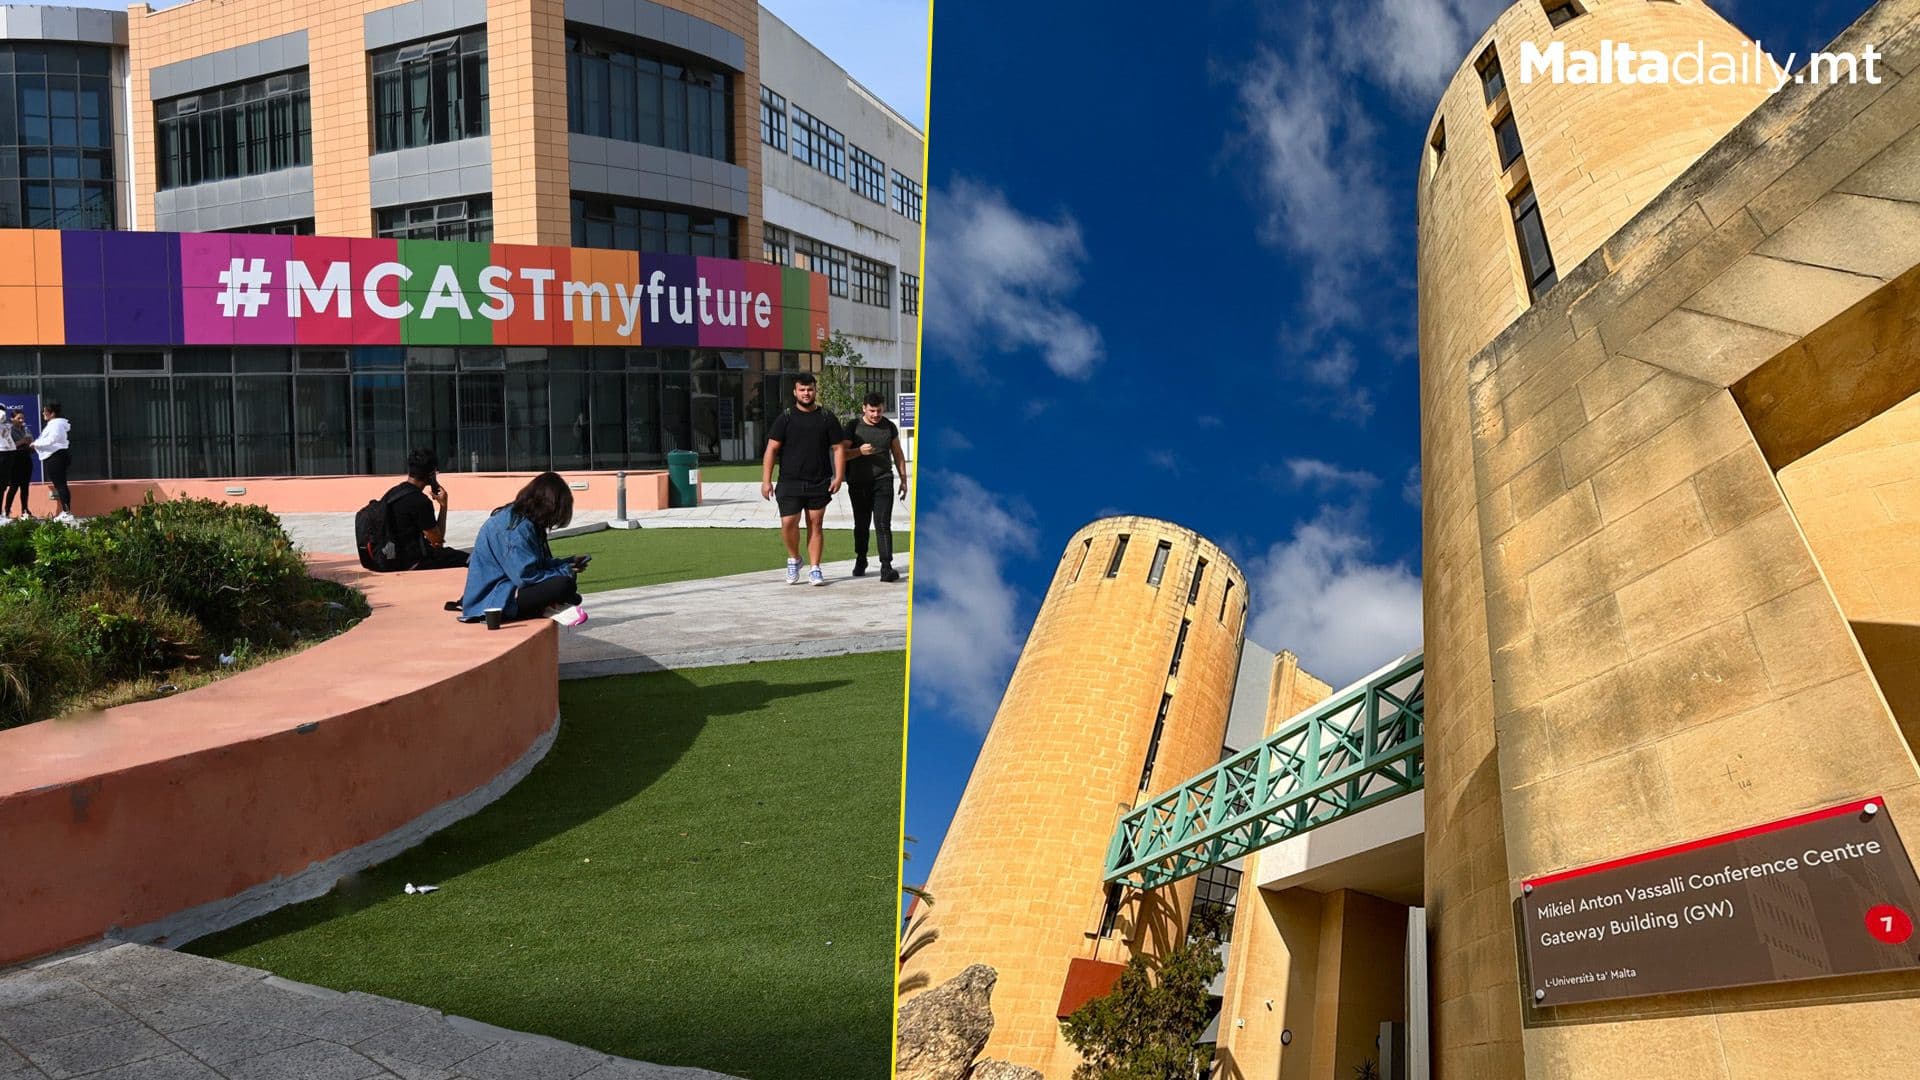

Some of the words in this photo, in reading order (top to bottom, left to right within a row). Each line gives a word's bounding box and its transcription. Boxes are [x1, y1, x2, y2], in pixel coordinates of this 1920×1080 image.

[1537, 898, 1576, 920] Mikiel
[1579, 891, 1623, 912] Anton
[1626, 877, 1685, 902] Vassalli
[1688, 857, 1799, 889] Conference
[1802, 838, 1882, 867] Centre
[1540, 924, 1606, 947] Gateway
[1610, 910, 1680, 936] Building
[1683, 899, 1735, 925] (GW)
[1879, 915, 1893, 932] 7
[1545, 970, 1595, 988] L-Università
[1610, 967, 1637, 981] Malta
